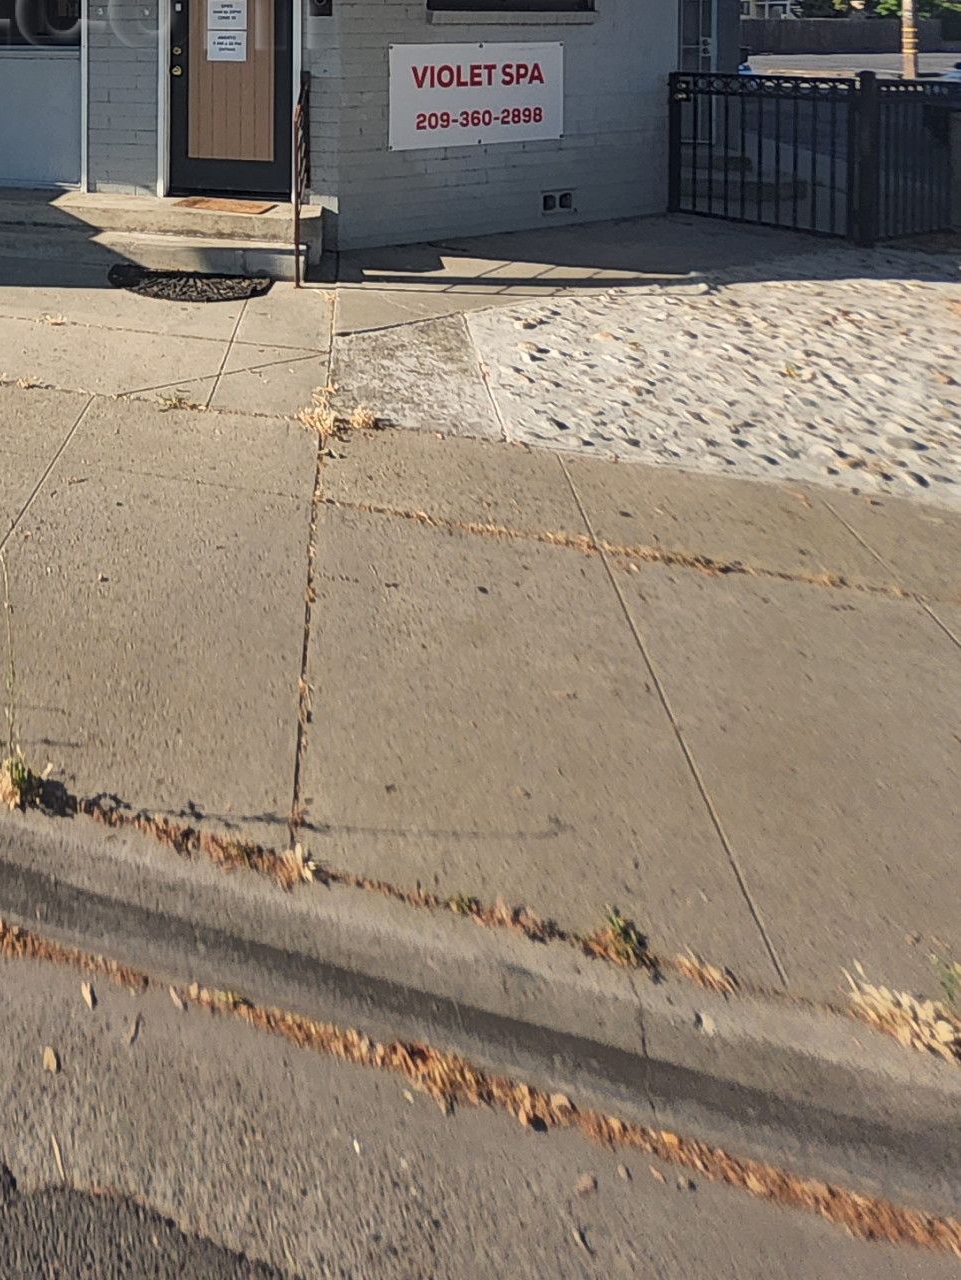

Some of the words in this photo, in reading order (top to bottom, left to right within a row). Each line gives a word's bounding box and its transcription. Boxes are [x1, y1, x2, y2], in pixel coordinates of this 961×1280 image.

[411, 63, 497, 89] VIOLET
[501, 62, 545, 86] SPA
[415, 106, 544, 131] 209-360-2898
